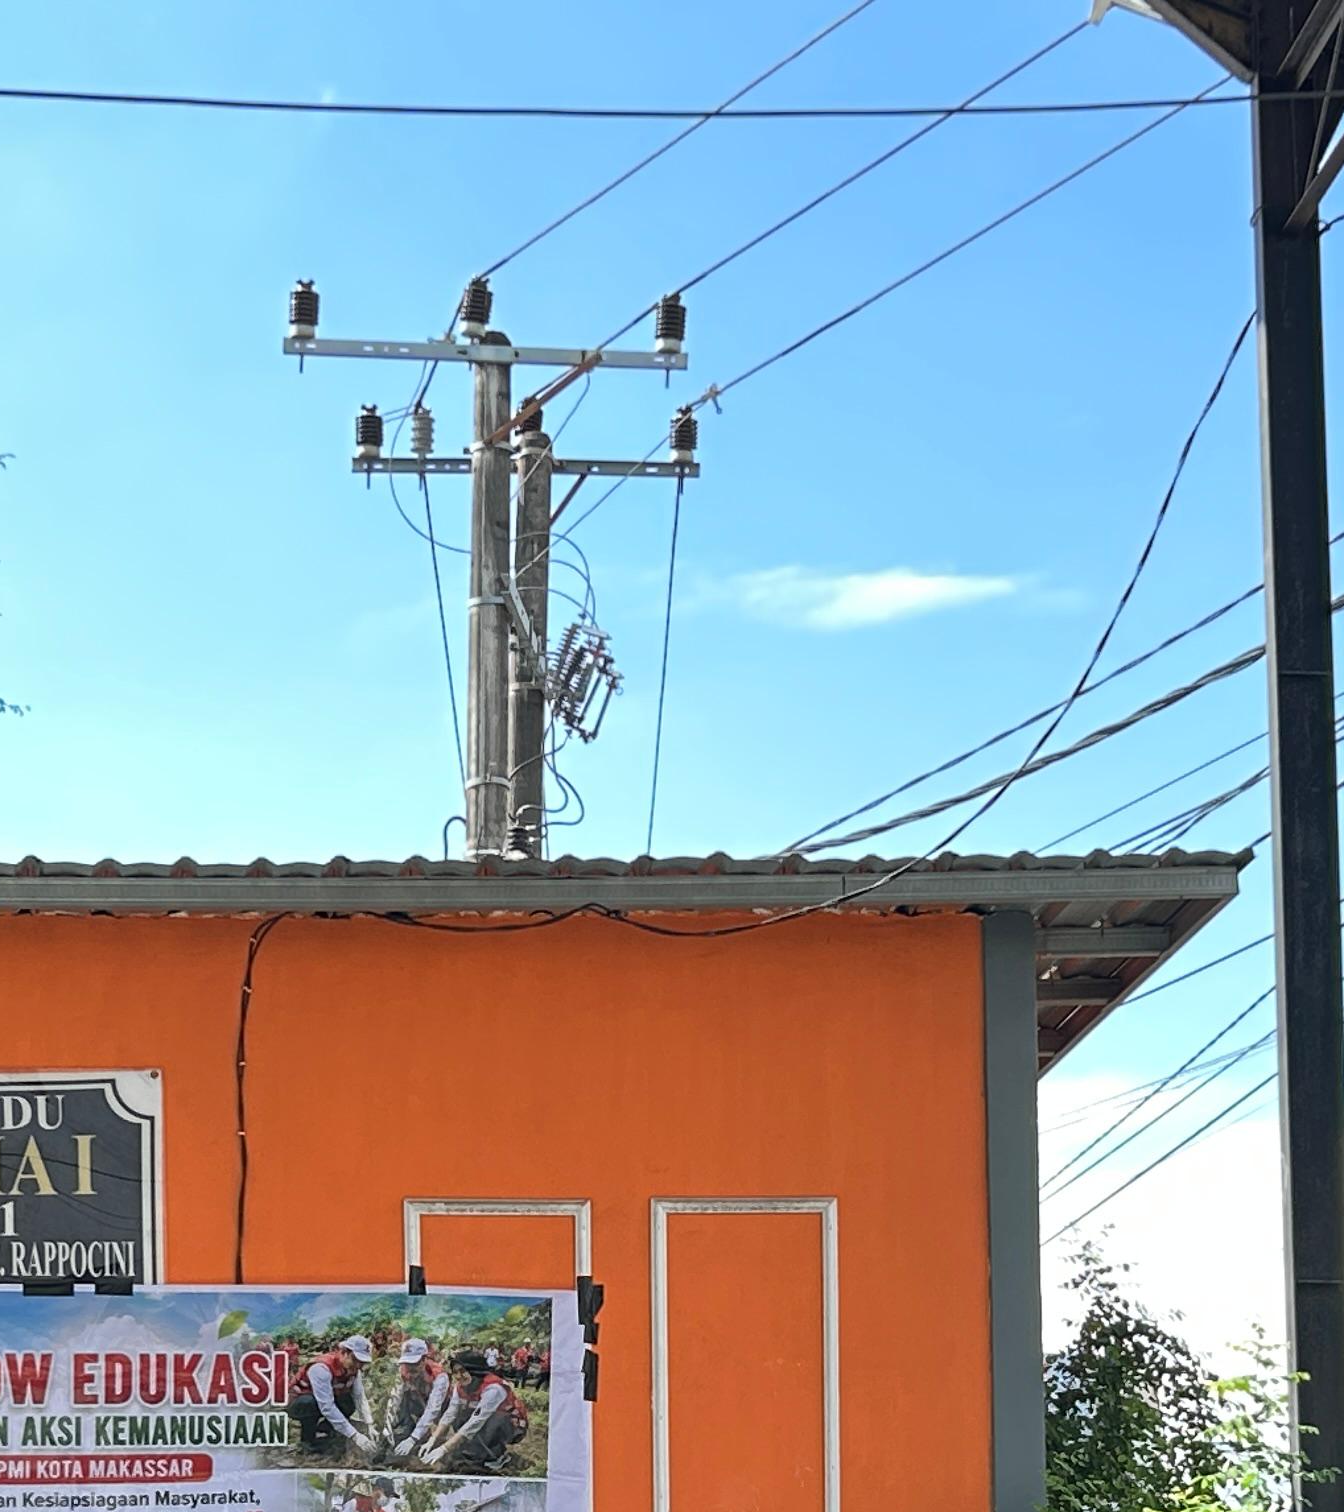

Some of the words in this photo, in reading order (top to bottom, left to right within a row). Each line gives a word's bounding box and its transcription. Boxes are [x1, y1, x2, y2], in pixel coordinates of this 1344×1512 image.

[71, 1135, 98, 1195] I
[11, 1240, 136, 1278] RAPPOCINI
[72, 1351, 289, 1406] EDUKASI
[22, 1414, 82, 1446] AKSI
[95, 1413, 289, 1446] KEMANUSIAAN
[35, 1460, 83, 1478] KOTA
[88, 1459, 193, 1478] MAKASSAR
[23, 1491, 149, 1510] Kesiapsiagaan
[155, 1490, 261, 1508] Masyarakat,
